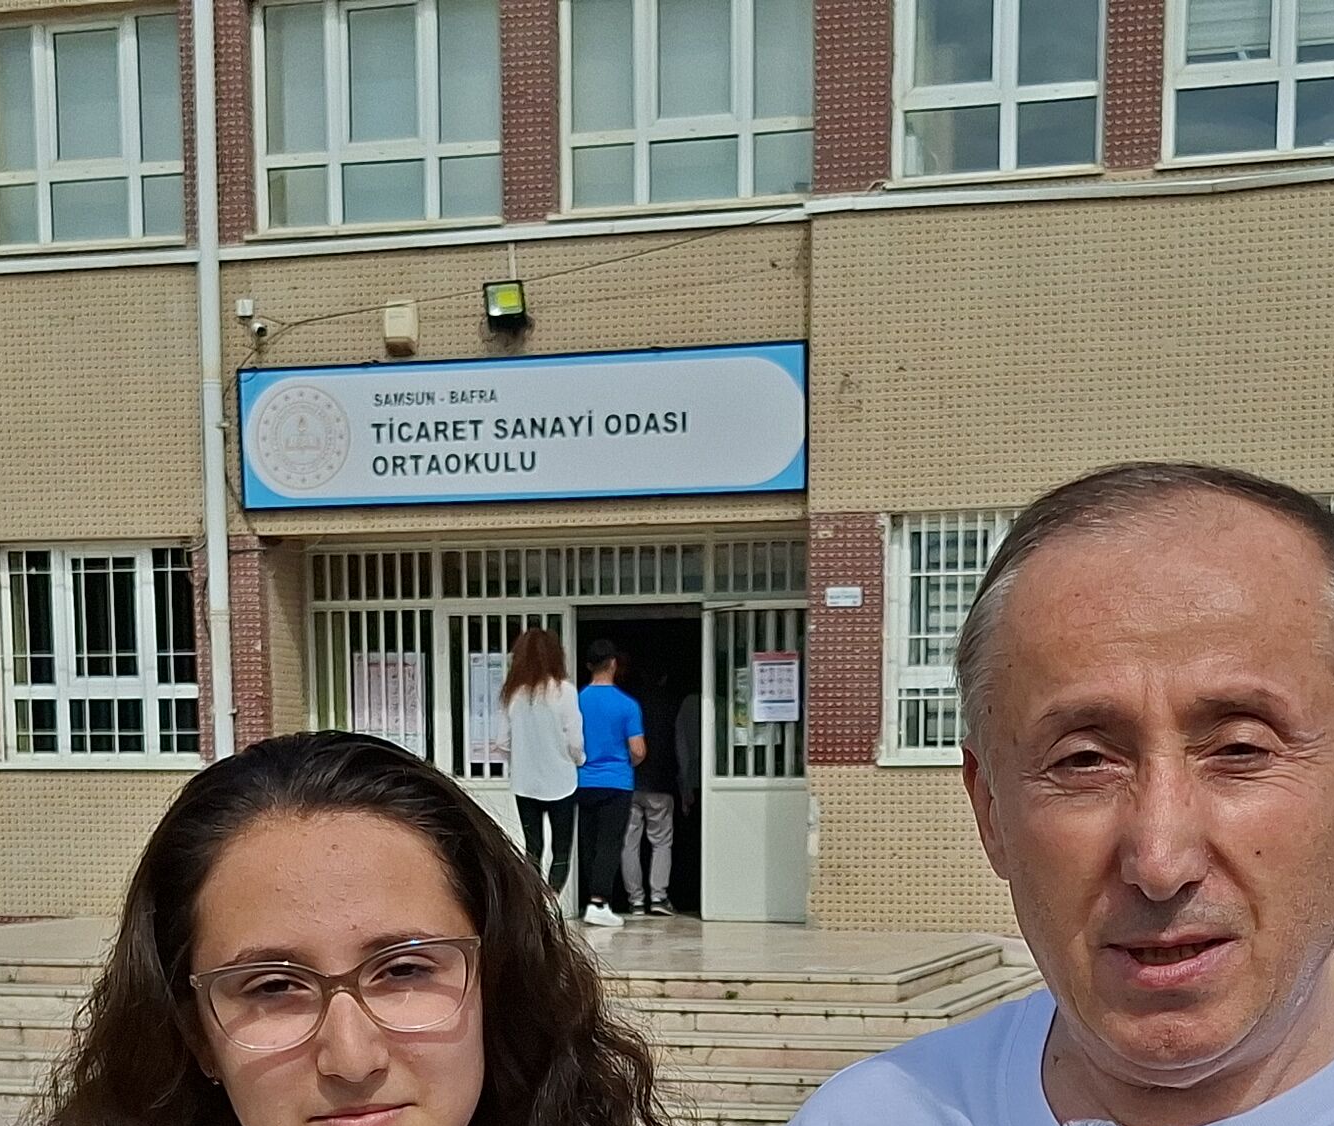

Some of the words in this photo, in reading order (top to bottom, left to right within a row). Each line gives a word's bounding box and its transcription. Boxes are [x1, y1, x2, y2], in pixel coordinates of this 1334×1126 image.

[373, 391, 436, 407] SAMSUN
[449, 389, 498, 405] BAFRA
[371, 417, 483, 443] TİCARET
[493, 409, 594, 440] SANAYİ
[604, 411, 688, 436] ODASI
[372, 451, 536, 476] ORTAOKULU
